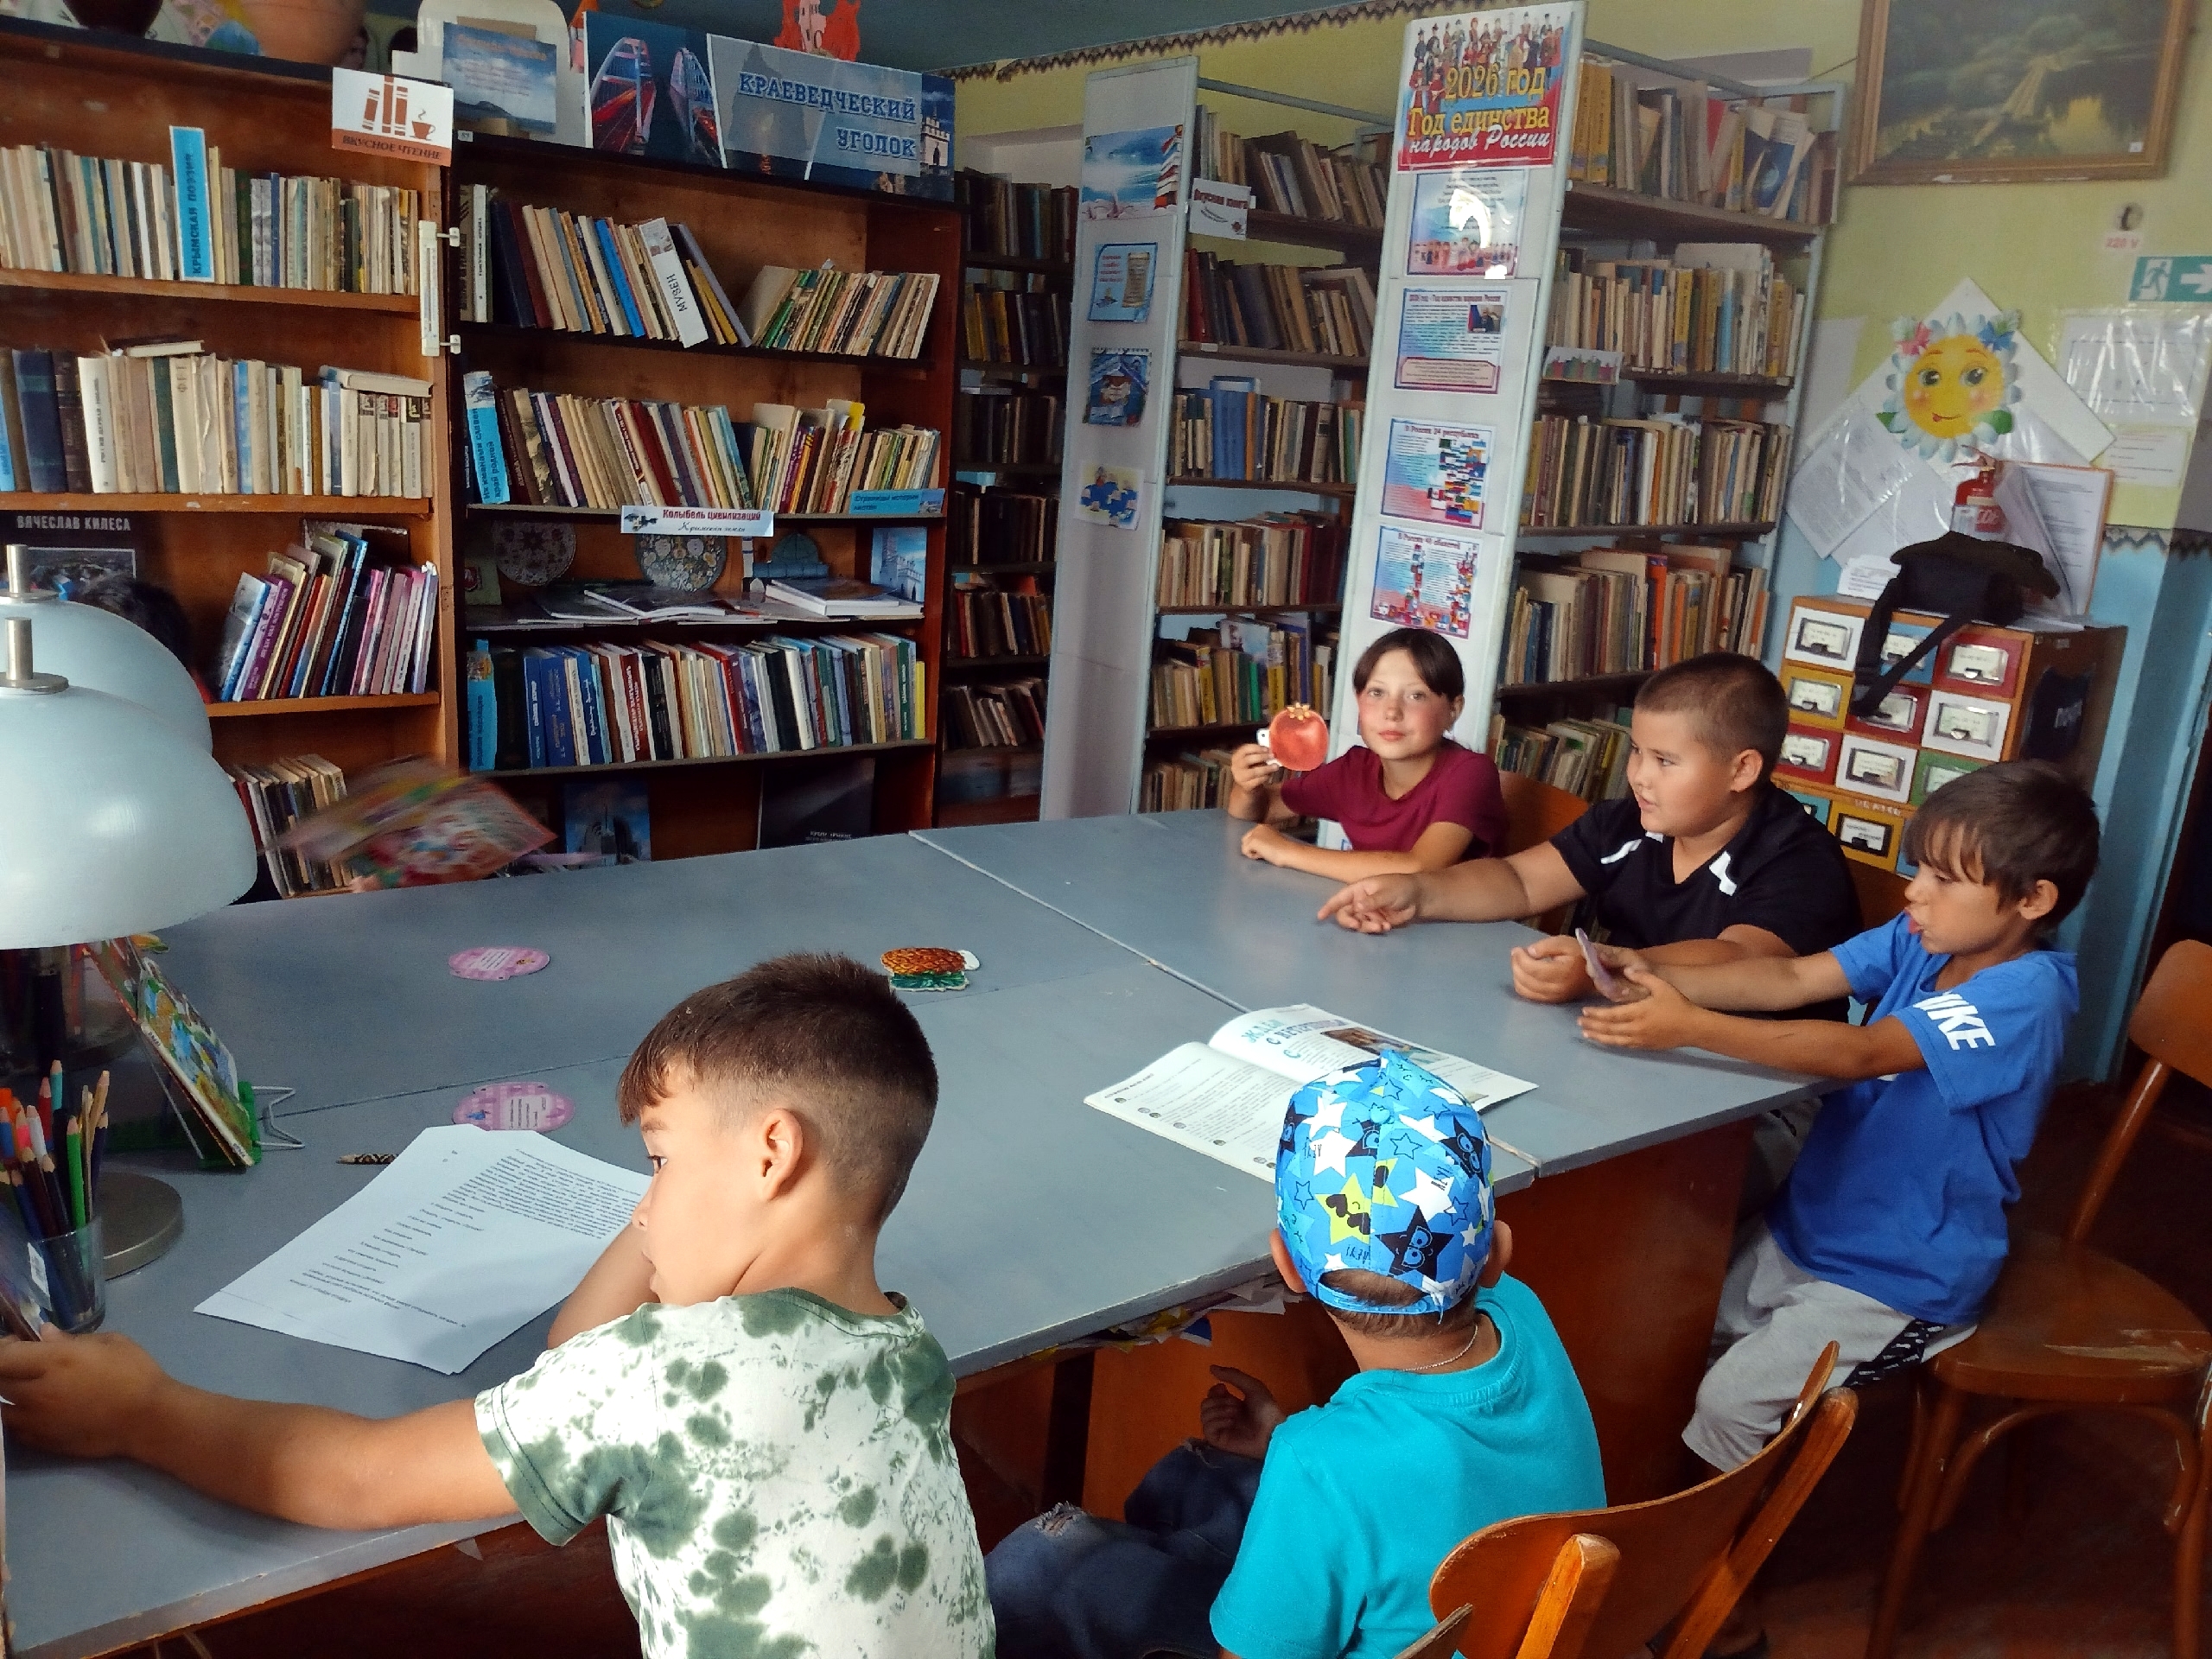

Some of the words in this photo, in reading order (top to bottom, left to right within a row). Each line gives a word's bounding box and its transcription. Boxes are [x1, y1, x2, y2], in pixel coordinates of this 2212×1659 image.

[738, 72, 918, 124] КРАЕВЕДЧЕСКИЙ
[1445, 64, 1499, 100] 2026
[1408, 108, 1446, 138] Год
[1451, 106, 1549, 136] единства
[342, 135, 396, 153] ВКУСНОЕ
[397, 144, 442, 160] ЧТЕНИЕ
[836, 127, 917, 160] УГОЛОК
[1409, 128, 1478, 158] народов
[1484, 124, 1550, 150] России
[188, 207, 201, 274] КРЫМСКАЯ
[17, 515, 80, 529] ВЯЧЕСЛАВ
[85, 517, 131, 531] КИЛЕСА
[663, 509, 706, 519] Колыбель
[708, 511, 761, 521] цивилизаций
[1912, 991, 1996, 1050] NIKE
